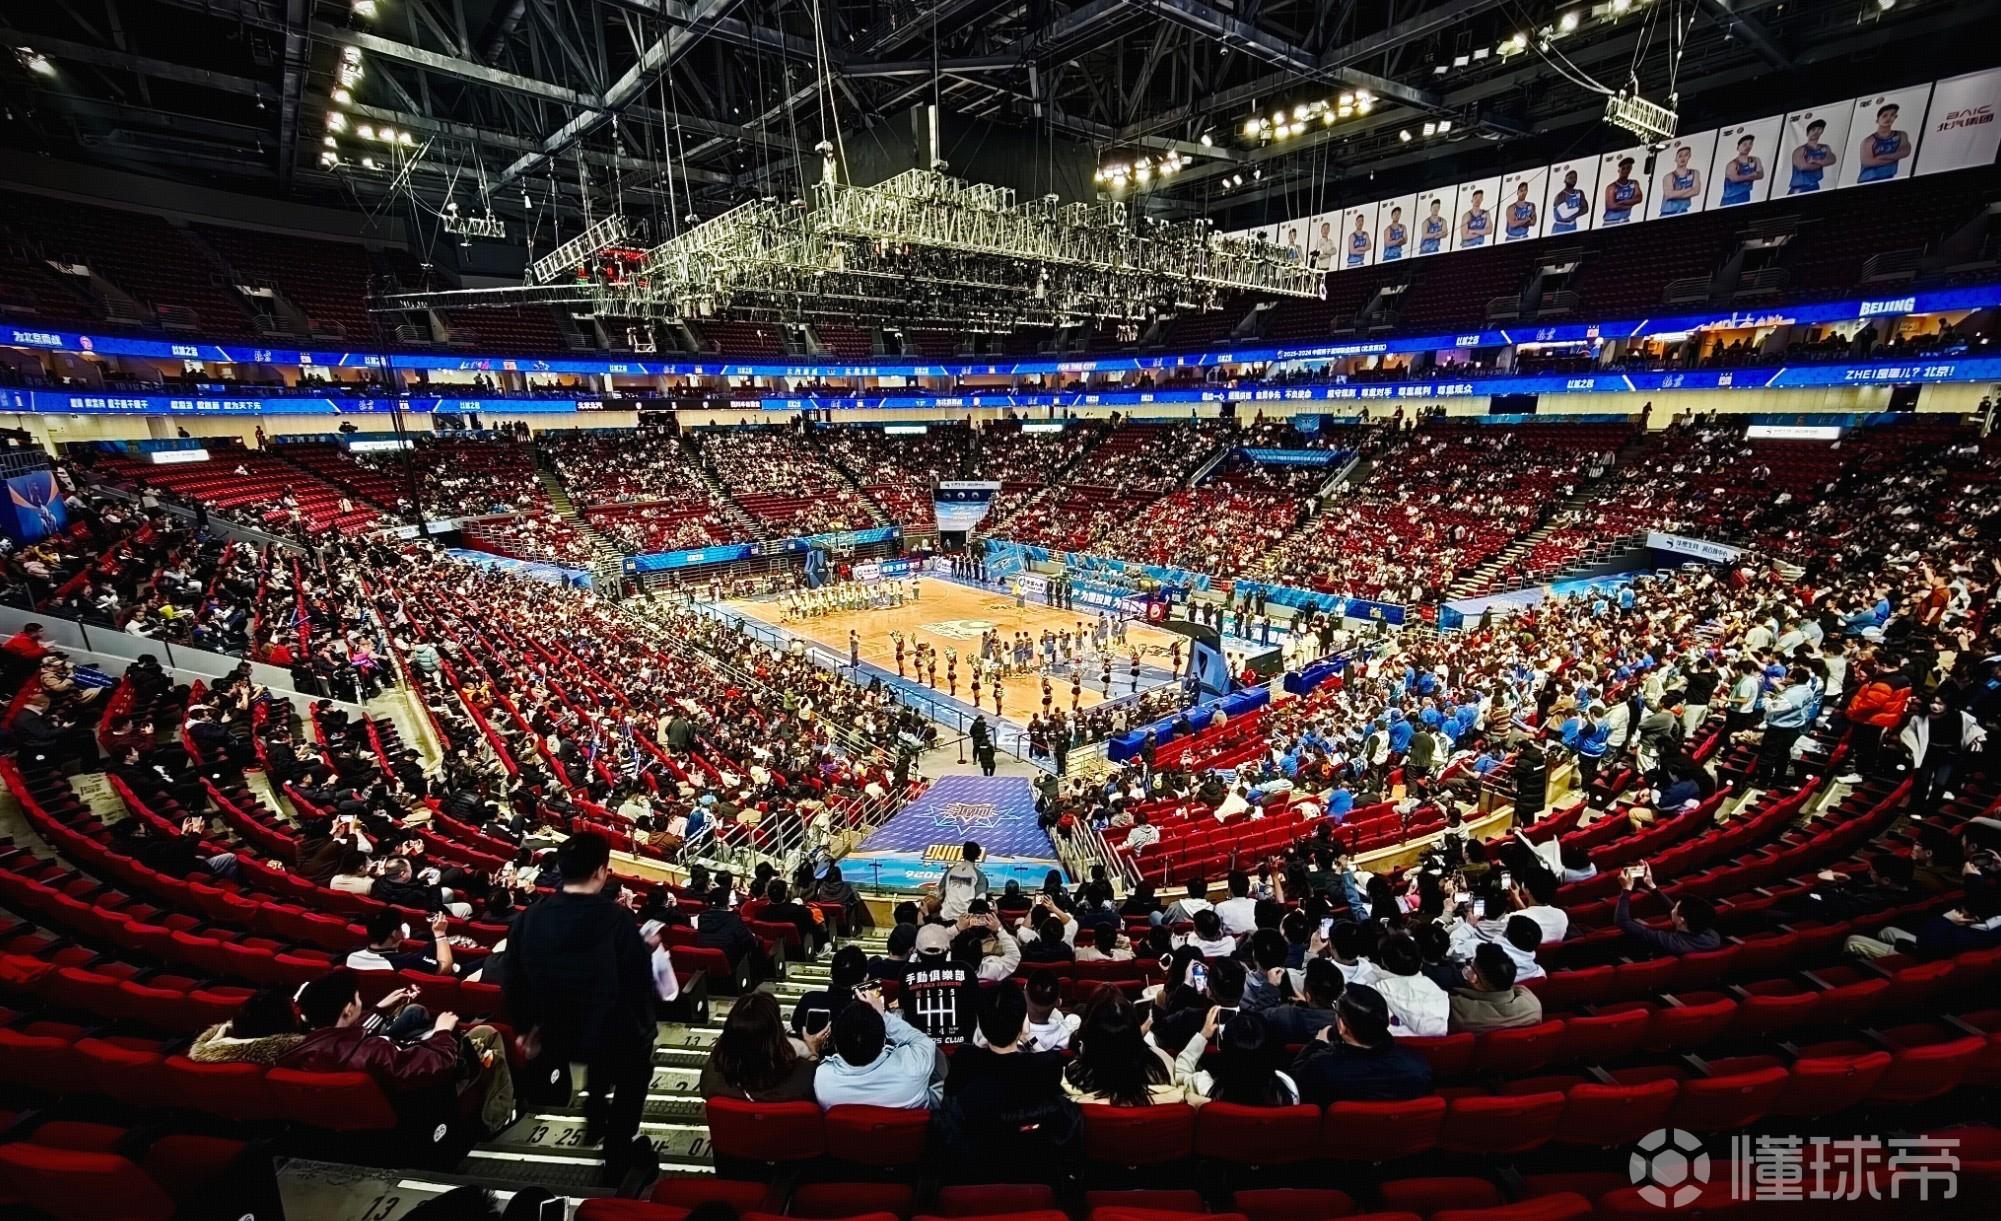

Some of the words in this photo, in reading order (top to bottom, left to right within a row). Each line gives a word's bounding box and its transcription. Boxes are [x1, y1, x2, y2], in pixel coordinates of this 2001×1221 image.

[1859, 297, 1916, 316] BEIJING
[906, 969, 965, 985] 手動俱樂部
[945, 1036, 964, 1044] CLUB
